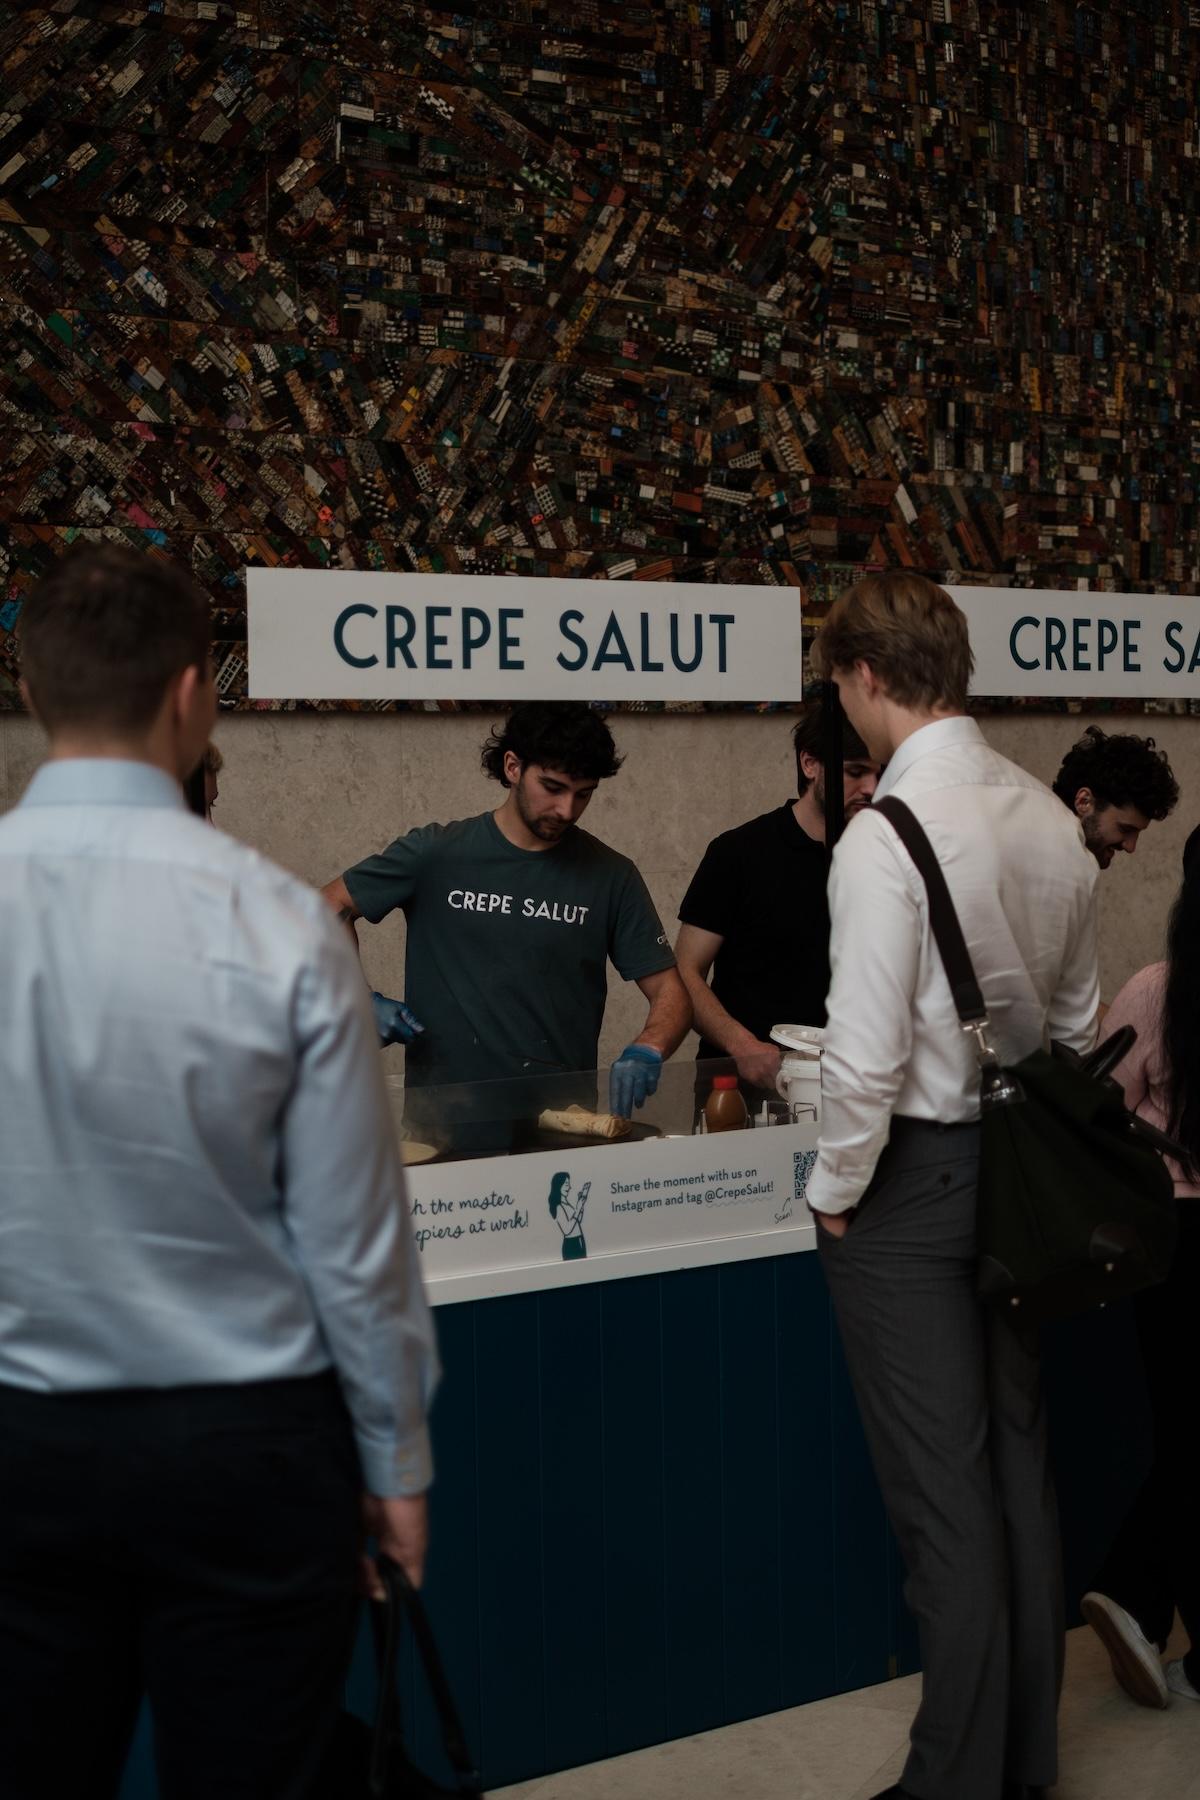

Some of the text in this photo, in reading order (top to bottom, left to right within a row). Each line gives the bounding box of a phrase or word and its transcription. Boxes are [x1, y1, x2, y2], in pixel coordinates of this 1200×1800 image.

[333, 603, 735, 673] CREPE SALUT
[1009, 615, 1141, 673] CREPE
[447, 890, 589, 925] CREPE SALUT
[610, 1168, 757, 1194] Share the moment with us on
[611, 1180, 775, 1213] Instagram and tag @CrepeSalut!
[410, 1190, 515, 1216] h the master
[415, 1209, 529, 1252] epiers at work!
